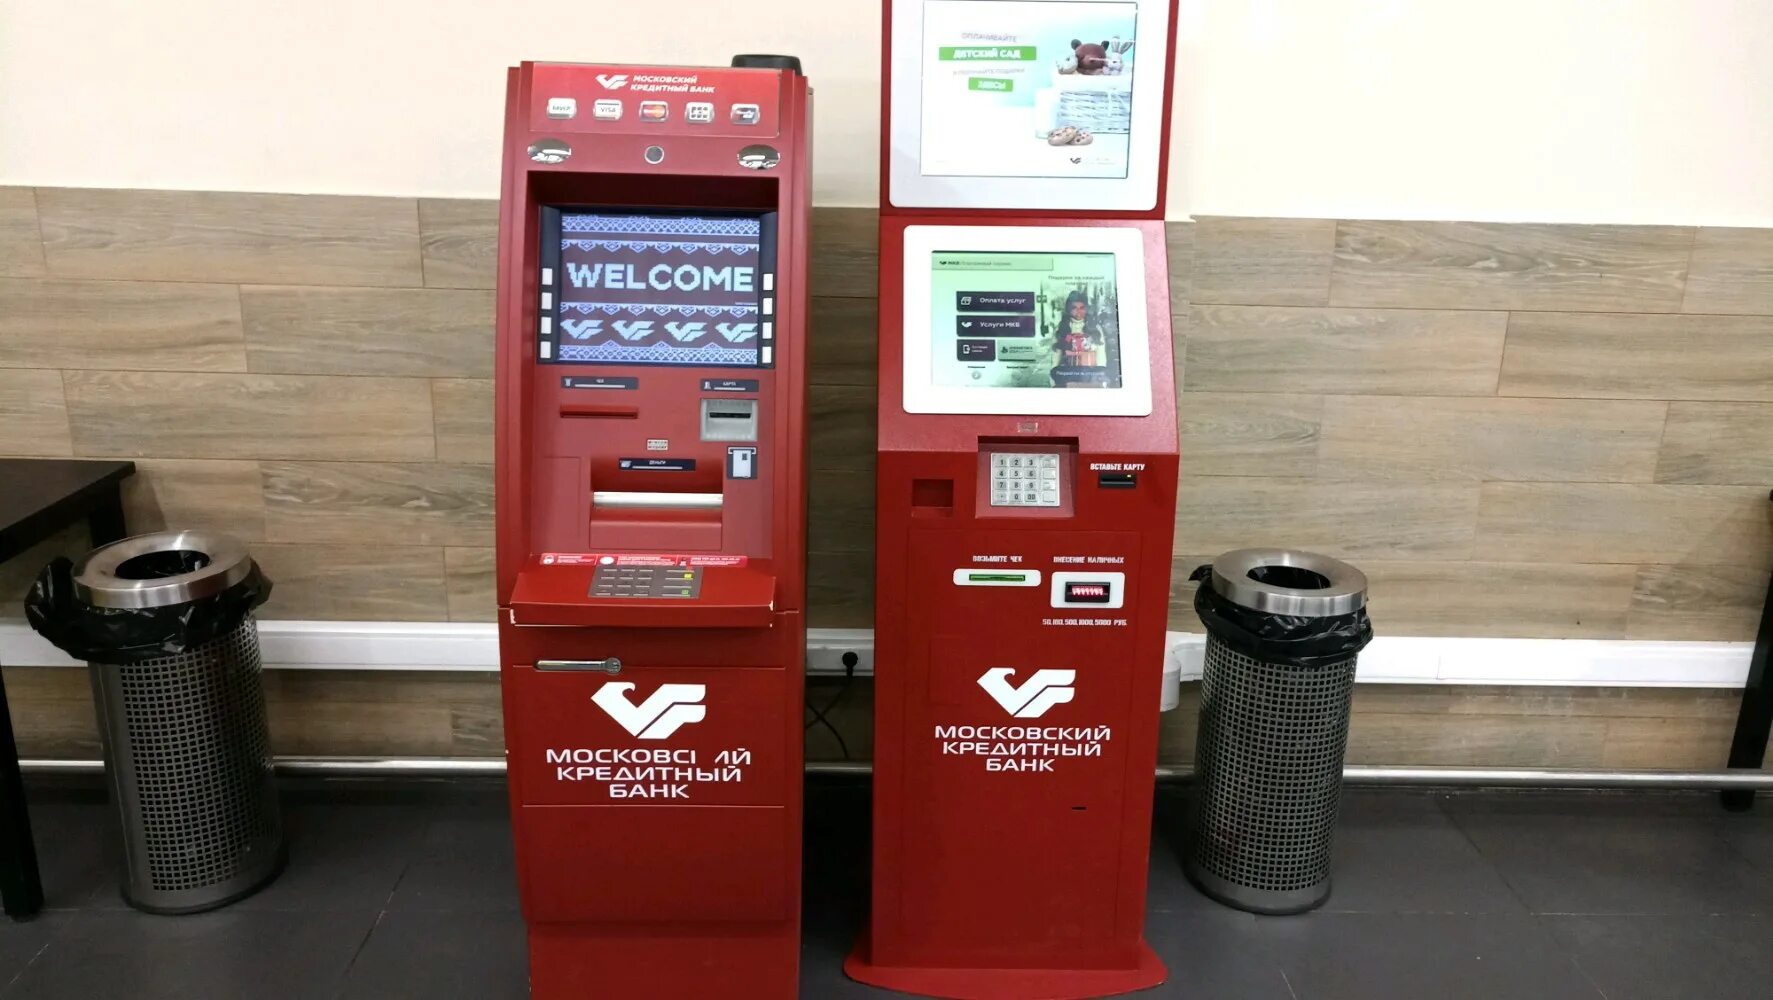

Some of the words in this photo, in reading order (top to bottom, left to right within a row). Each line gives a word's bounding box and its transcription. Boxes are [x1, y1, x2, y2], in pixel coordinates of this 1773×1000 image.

[953, 48, 998, 59] ДЕТСКИЙ
[1000, 49, 1021, 59] САД
[633, 75, 698, 84] МОСКОВСКИЙ
[630, 84, 688, 93] КРЕДИТНЫЙ
[689, 86, 715, 94] БАНК
[566, 262, 754, 292] WELCOME
[1006, 298, 1026, 306] услуг
[980, 321, 1004, 329] Услуги
[1090, 463, 1122, 471] ВСТАВЬТЕ
[1123, 463, 1146, 471] КАРТУ
[972, 555, 1008, 563] ВОЗЬМИТЕ
[1010, 555, 1023, 563] ЧЕК
[1053, 556, 1085, 564] ВНЕСЕНИЕ
[1087, 556, 1124, 564] НАЛИЧНЫХ
[935, 725, 1111, 741] МОСКОВСКИЙ
[943, 741, 1101, 757] КРЕДИТНЫЙ
[986, 758, 1055, 772] БАНК
[557, 766, 742, 782] КРЕДИТНЫЙ
[609, 784, 690, 798] БАНК
